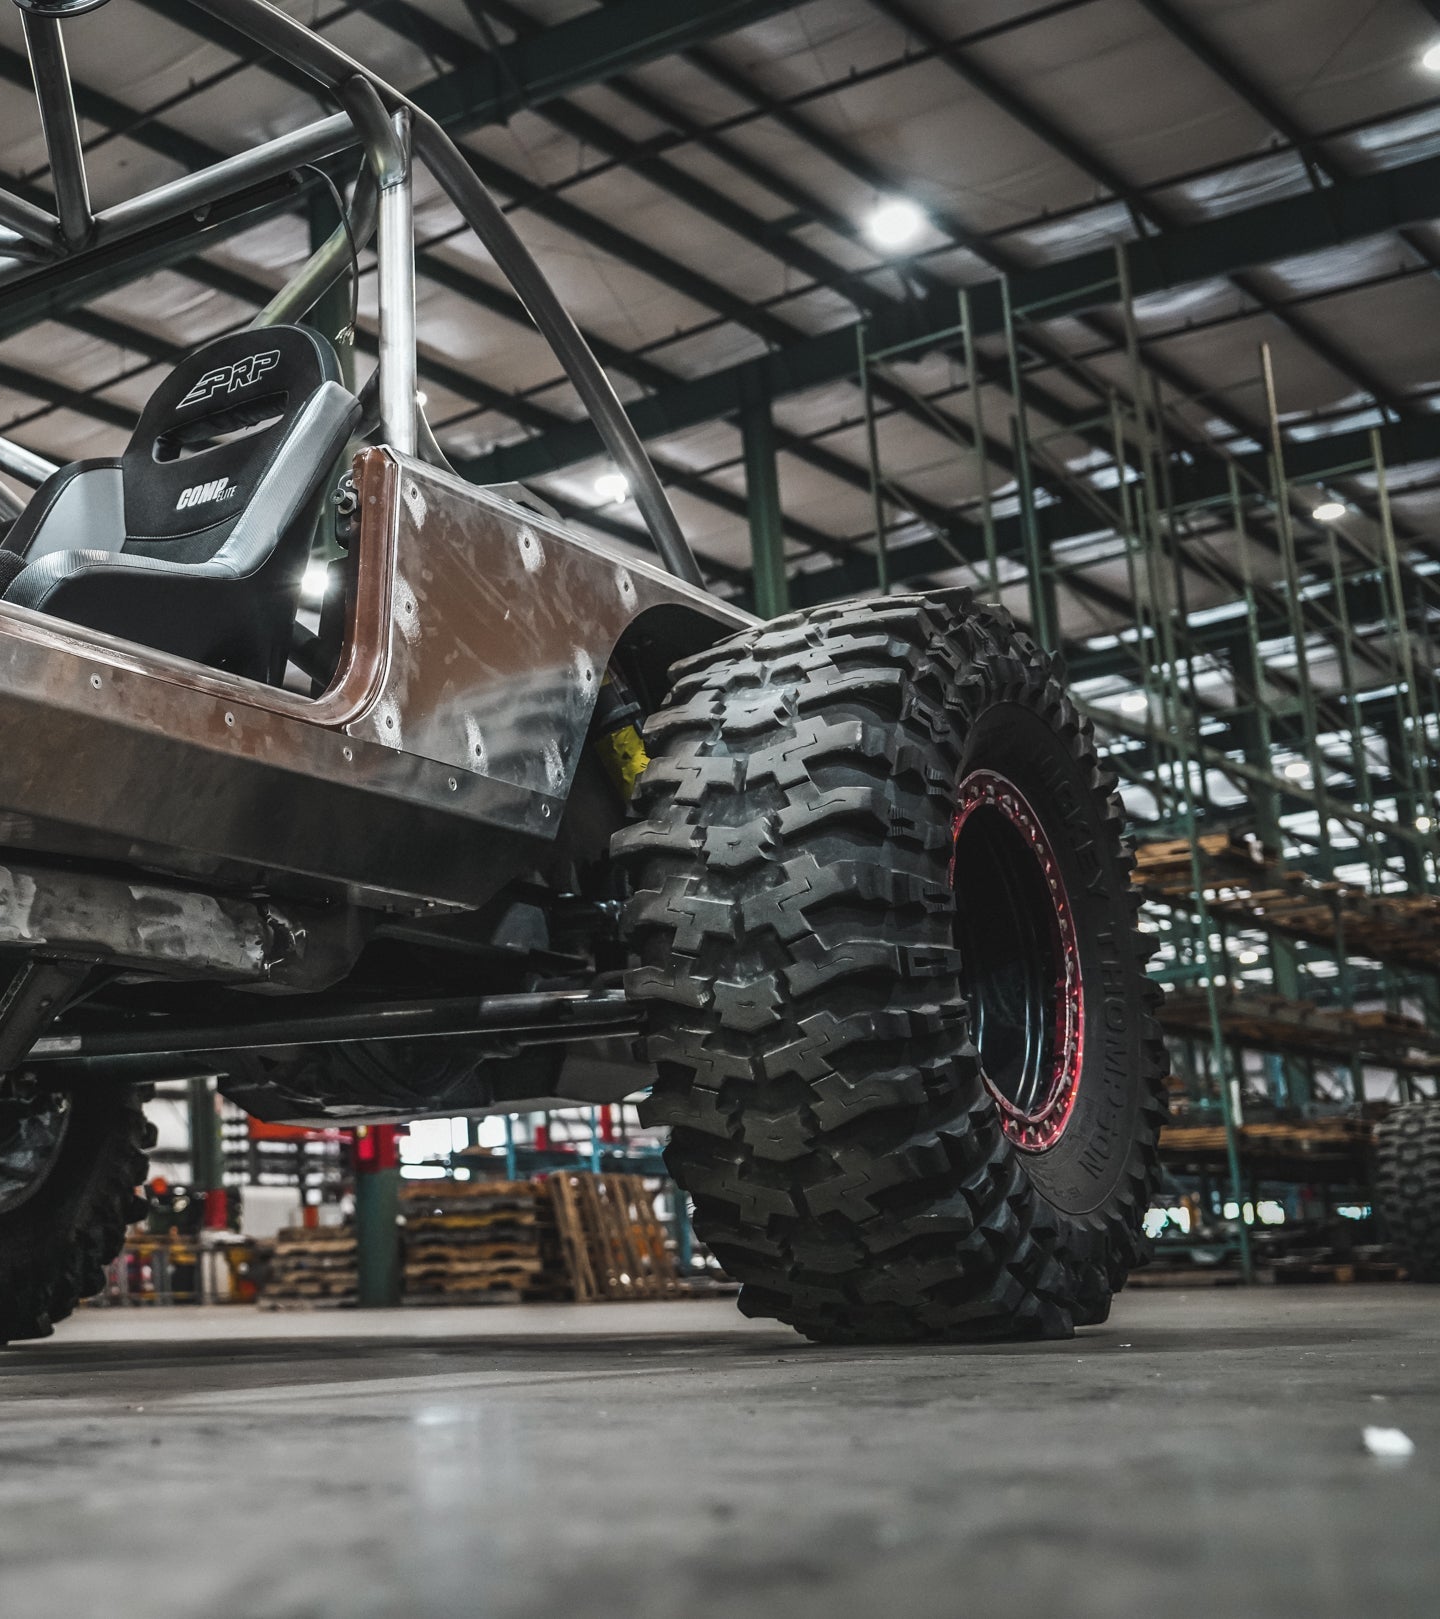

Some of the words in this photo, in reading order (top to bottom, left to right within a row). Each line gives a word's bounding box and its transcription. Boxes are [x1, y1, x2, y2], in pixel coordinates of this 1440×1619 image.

[175, 349, 281, 409] PRP
[176, 476, 229, 510] COMP
[1078, 920, 1127, 1180] THOMPSON
